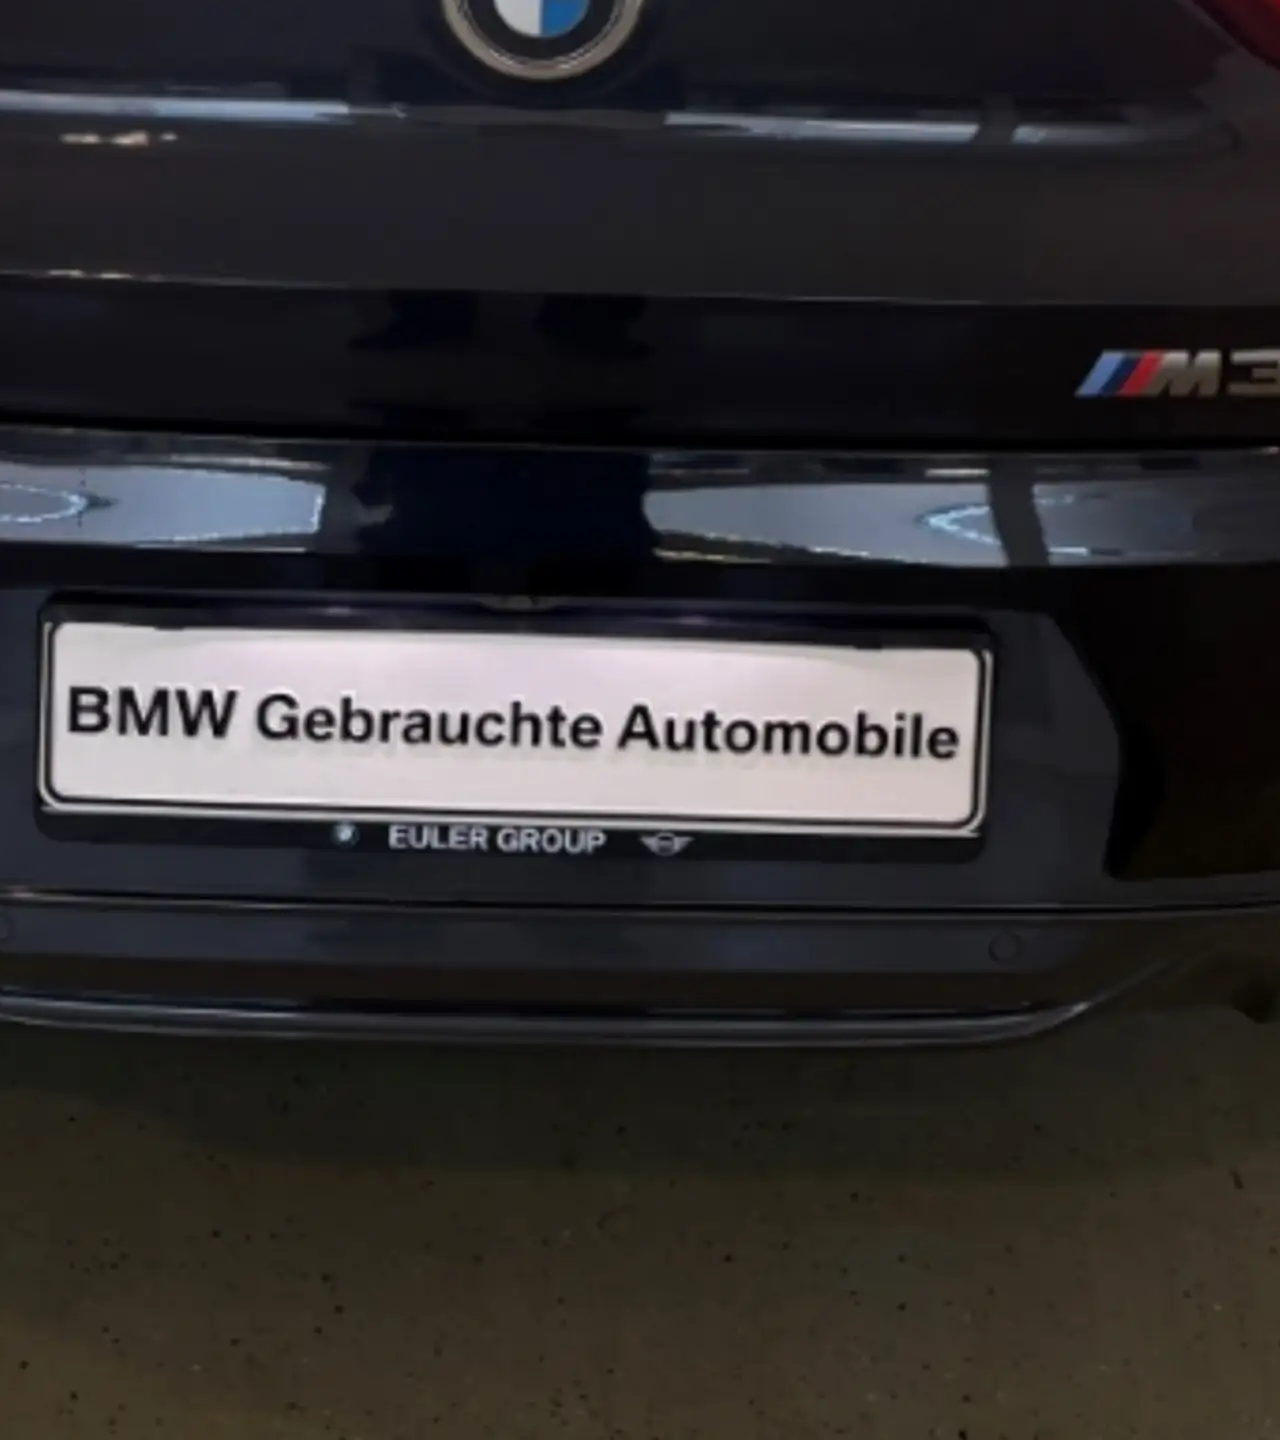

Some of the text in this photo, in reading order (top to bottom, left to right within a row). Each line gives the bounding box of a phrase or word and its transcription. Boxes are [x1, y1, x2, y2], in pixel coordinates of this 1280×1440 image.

[67, 685, 961, 761] BMW Gebrauchte Automobile
[388, 823, 608, 855] EULER GROUP
